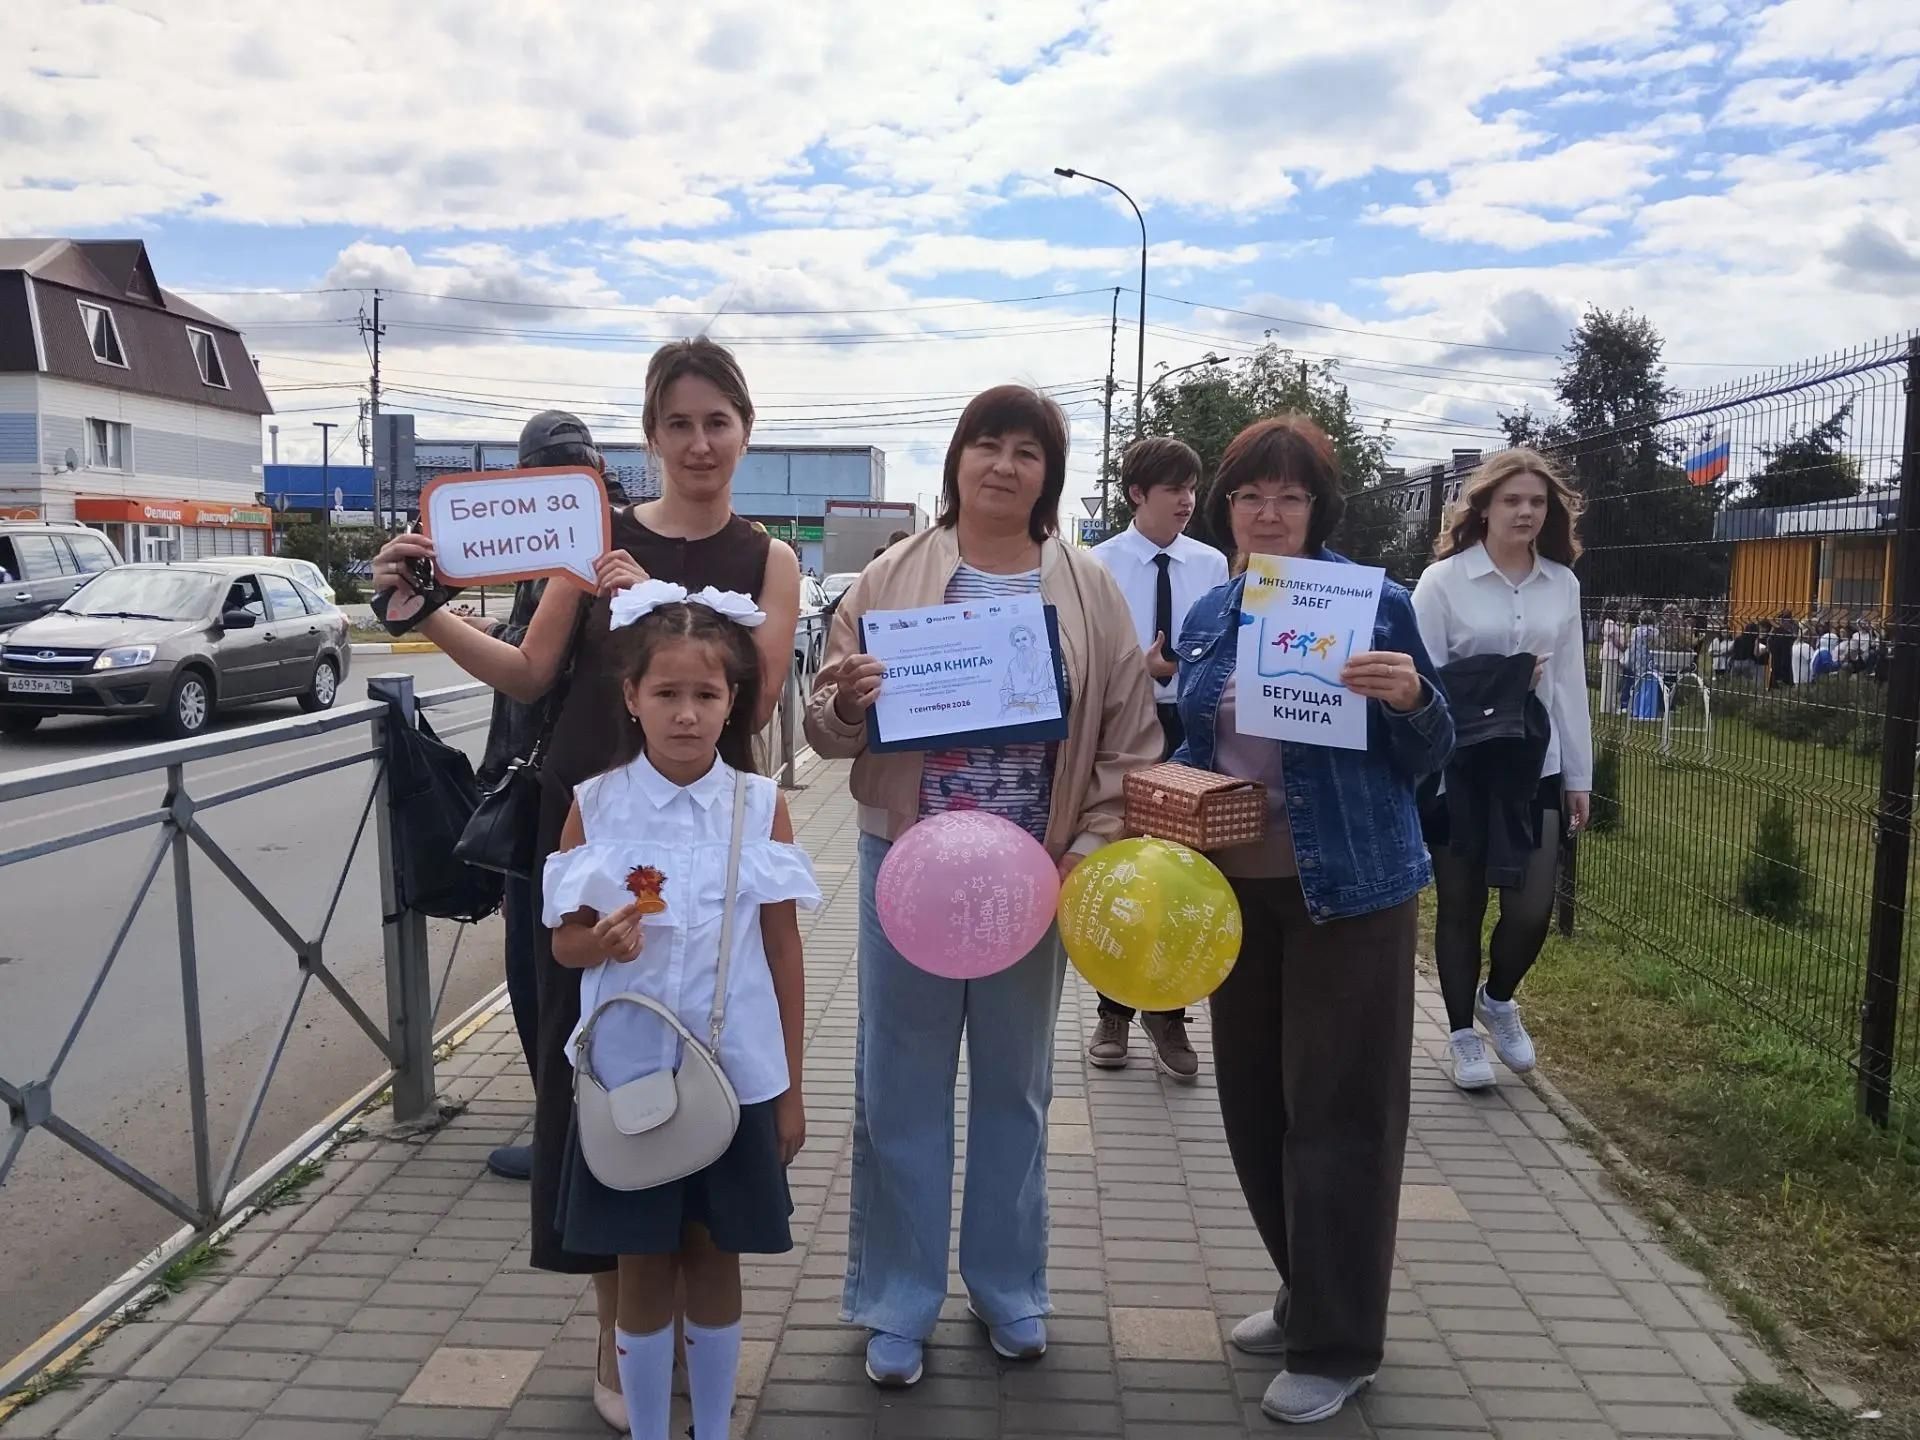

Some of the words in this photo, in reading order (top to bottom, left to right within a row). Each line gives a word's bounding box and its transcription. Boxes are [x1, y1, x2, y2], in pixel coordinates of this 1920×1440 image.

[450, 496, 537, 521] Бегом
[546, 493, 580, 512] за
[462, 528, 560, 560] книгой
[569, 526, 576, 549] !
[1258, 576, 1373, 600] ИНТЕЛЛЕКТУАЛЬНЫЙ
[1291, 595, 1332, 611] ЗАБЕГ
[944, 655, 993, 672] КНИГА»
[1262, 684, 1343, 707] БЕГУЩАЯ
[914, 702, 951, 715] сентября
[952, 698, 971, 710] 2026
[1273, 705, 1332, 725] КНИГА
